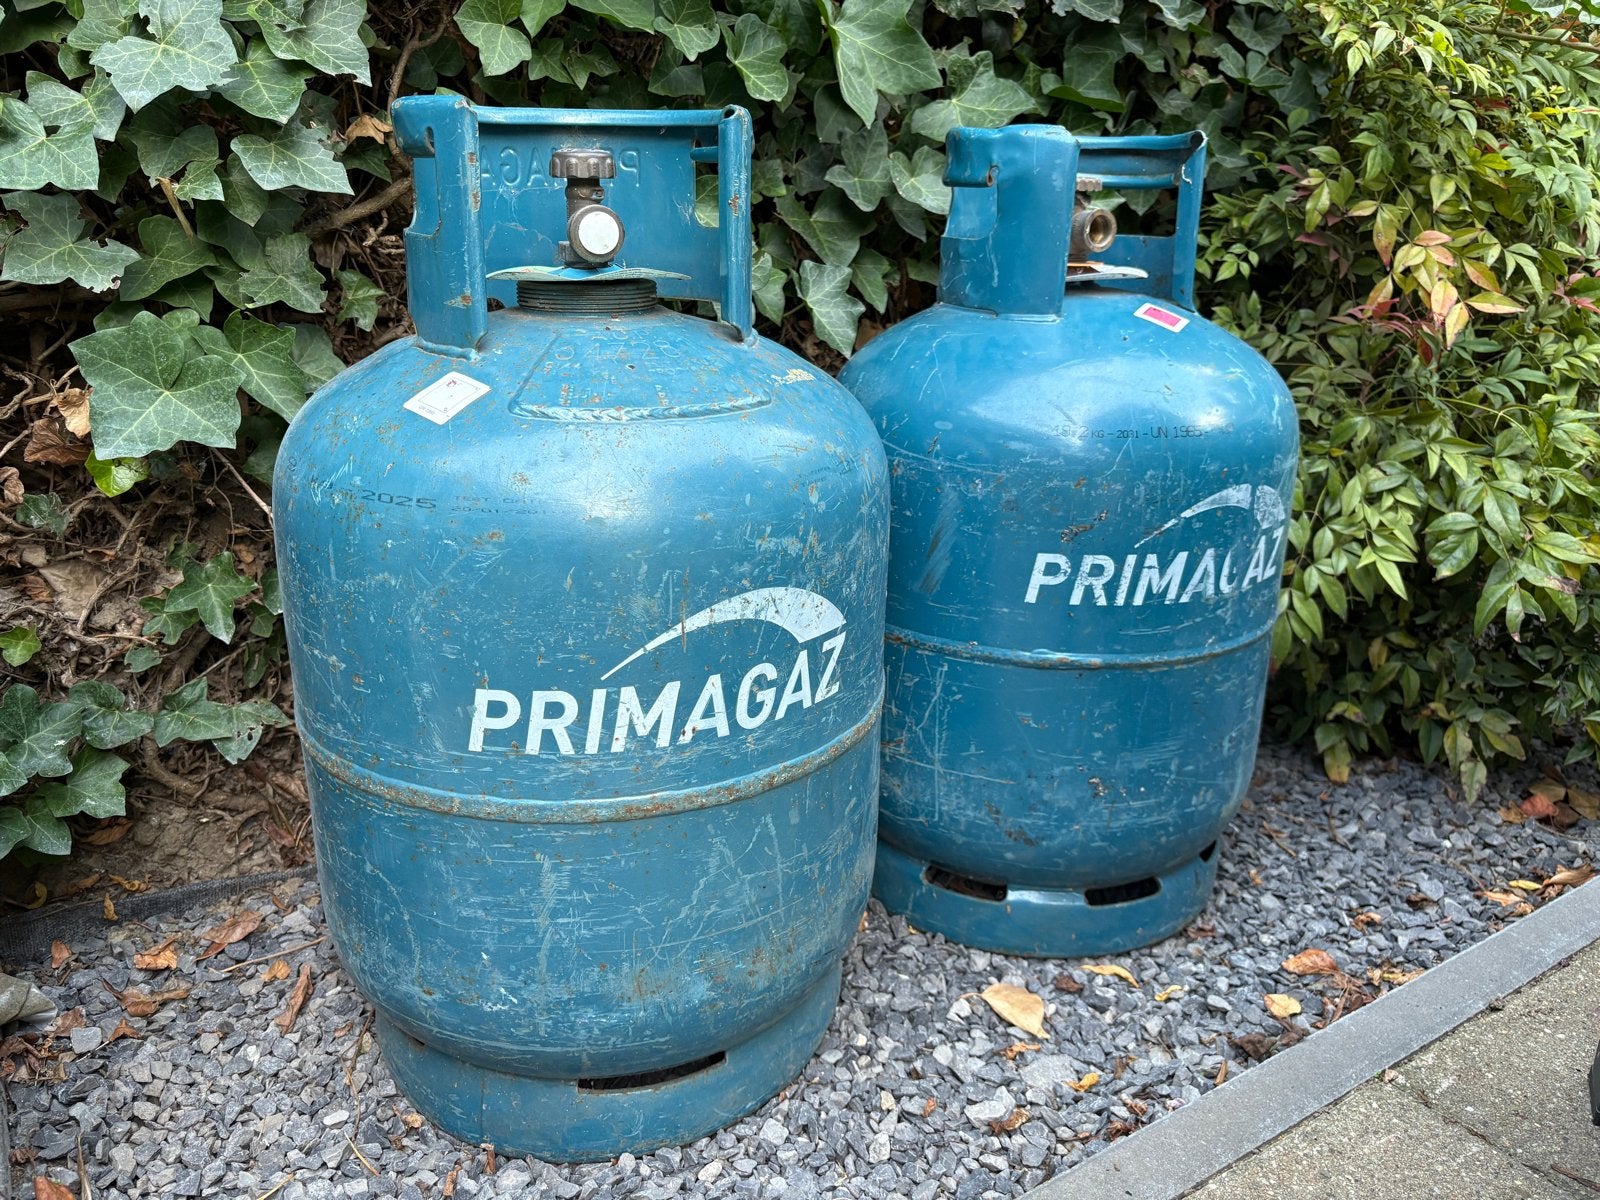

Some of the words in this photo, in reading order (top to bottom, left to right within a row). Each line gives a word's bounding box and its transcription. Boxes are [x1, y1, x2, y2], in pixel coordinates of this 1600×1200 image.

[1091, 429, 1105, 439] KG
[1150, 425, 1168, 439] UN
[361, 489, 438, 510] 2025
[467, 631, 847, 756] PRIMAGAZ
